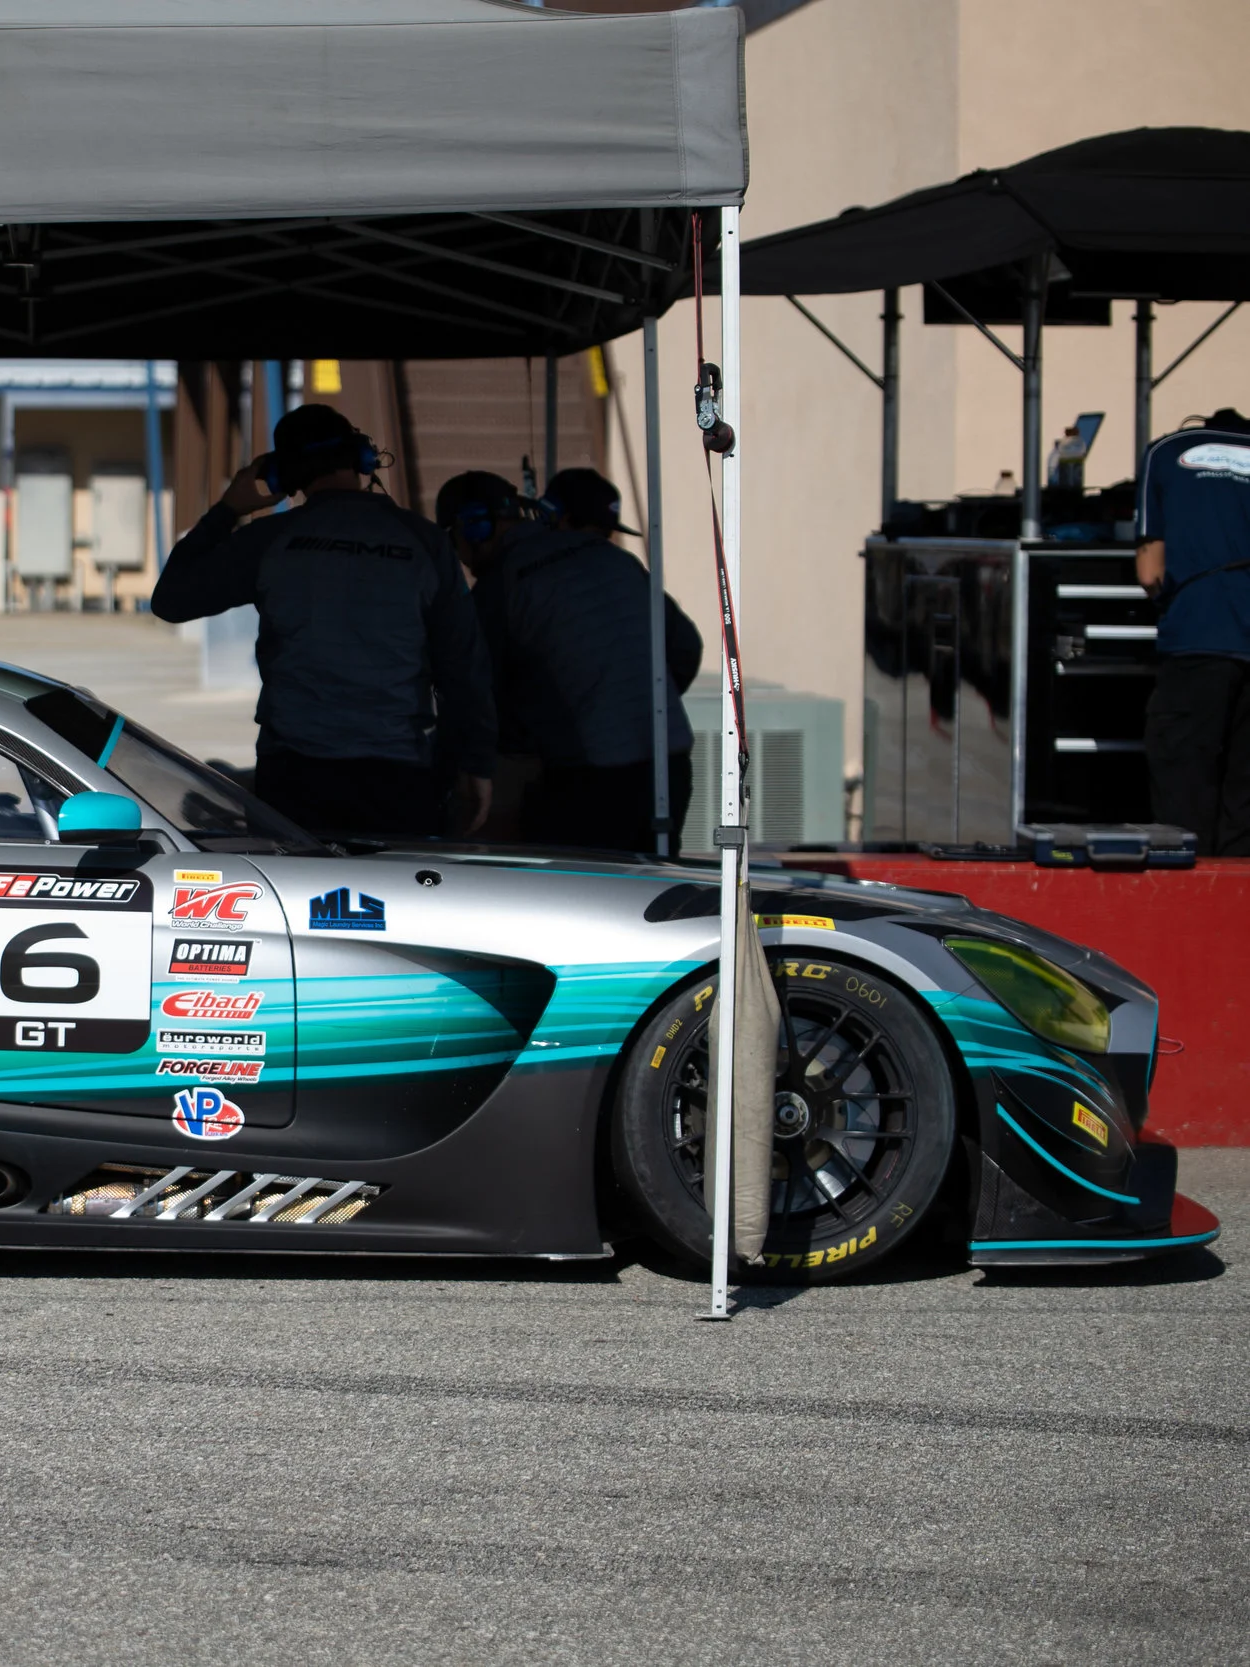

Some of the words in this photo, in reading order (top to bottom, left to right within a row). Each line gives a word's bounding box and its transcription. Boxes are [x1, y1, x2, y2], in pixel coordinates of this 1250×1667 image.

[730, 657, 740, 684] HUSKY
[172, 888, 256, 920] WC
[310, 886, 385, 919] MLS
[171, 920, 200, 928] World
[200, 921, 244, 931] Challenge
[762, 917, 828, 927] PIRELLI
[0, 922, 101, 1004] 6
[176, 943, 248, 962] OPTIMA
[162, 991, 261, 1019] Eibach
[694, 985, 713, 1012] P
[845, 976, 887, 1009] 0601
[15, 1021, 76, 1047] GT
[158, 1060, 263, 1077] FORGELINE
[178, 1091, 222, 1136] VP
